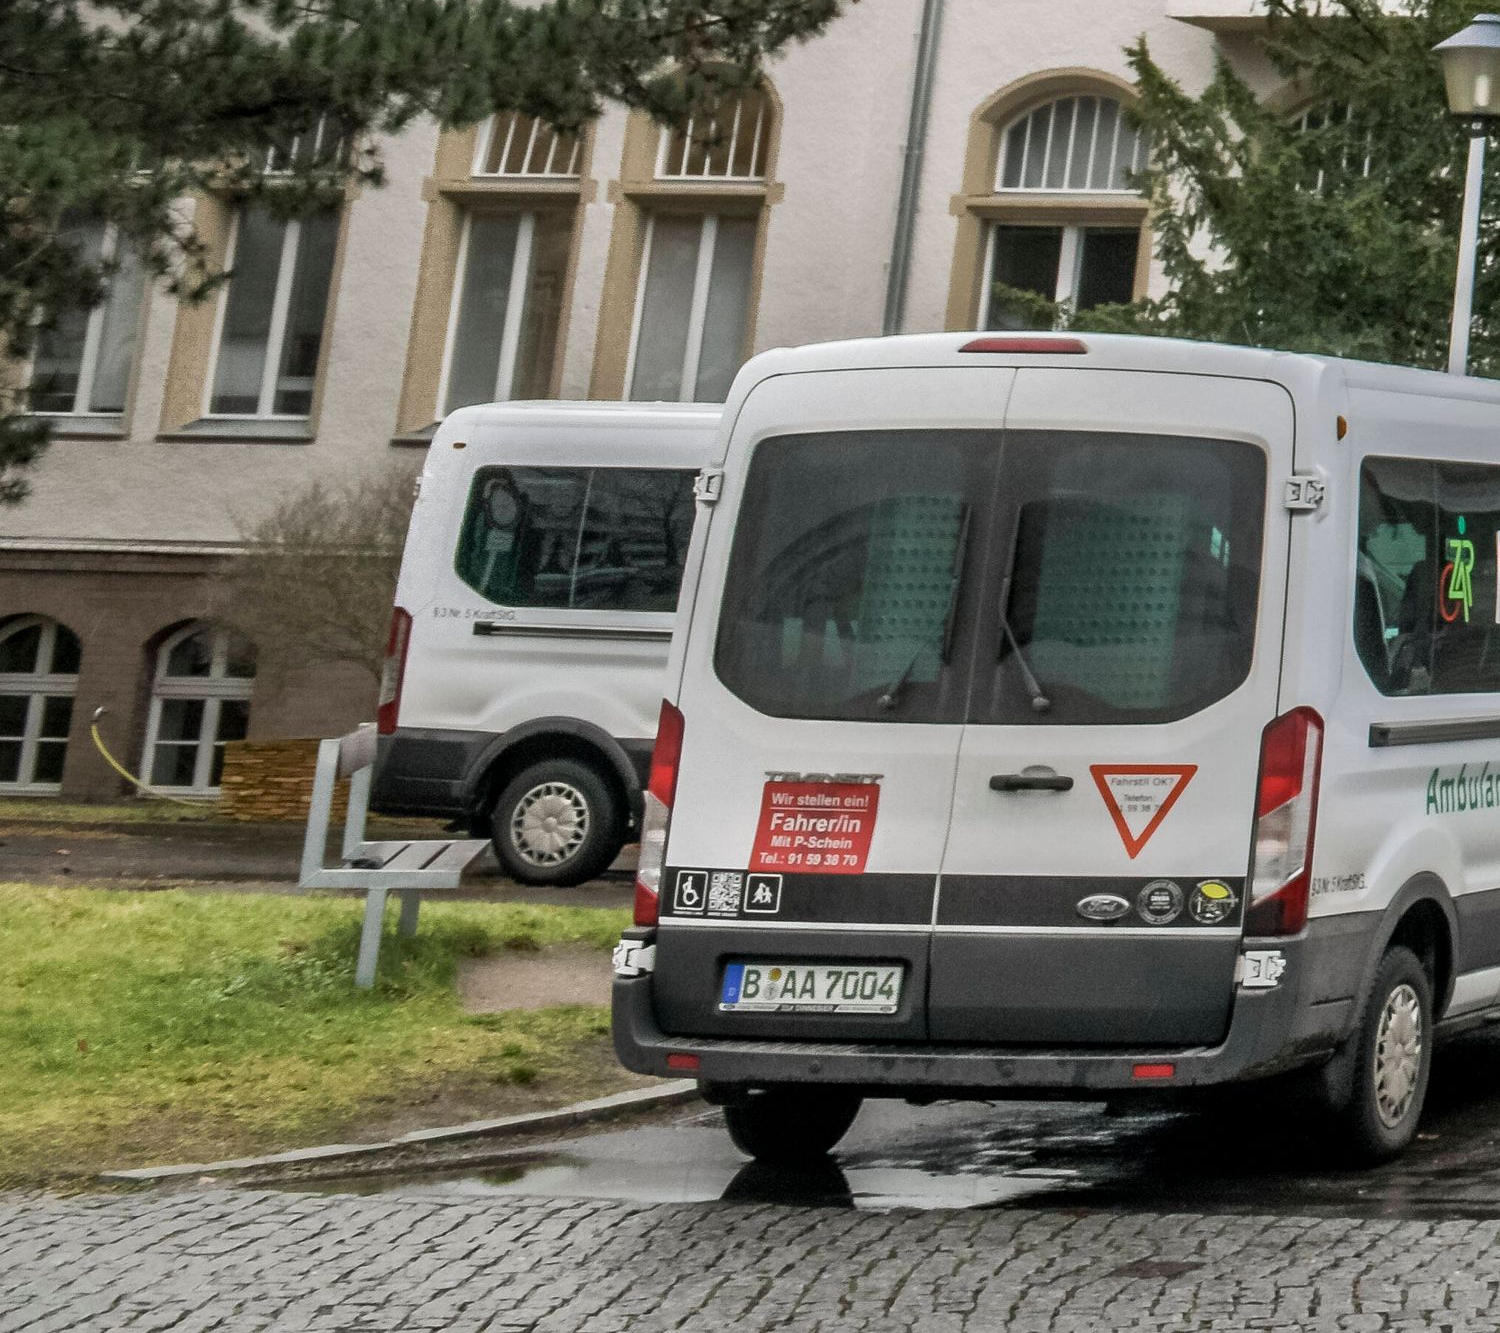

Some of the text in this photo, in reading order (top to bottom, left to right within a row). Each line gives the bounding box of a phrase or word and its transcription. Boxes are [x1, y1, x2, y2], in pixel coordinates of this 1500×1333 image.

[772, 792, 869, 807] Wir stellen ein!
[770, 812, 861, 833] Fahrer/in
[770, 835, 852, 849] Mit P-Schein
[787, 853, 801, 865] 91
[742, 969, 761, 999] B
[780, 970, 815, 1000] AA
[826, 970, 895, 1000] 7004
